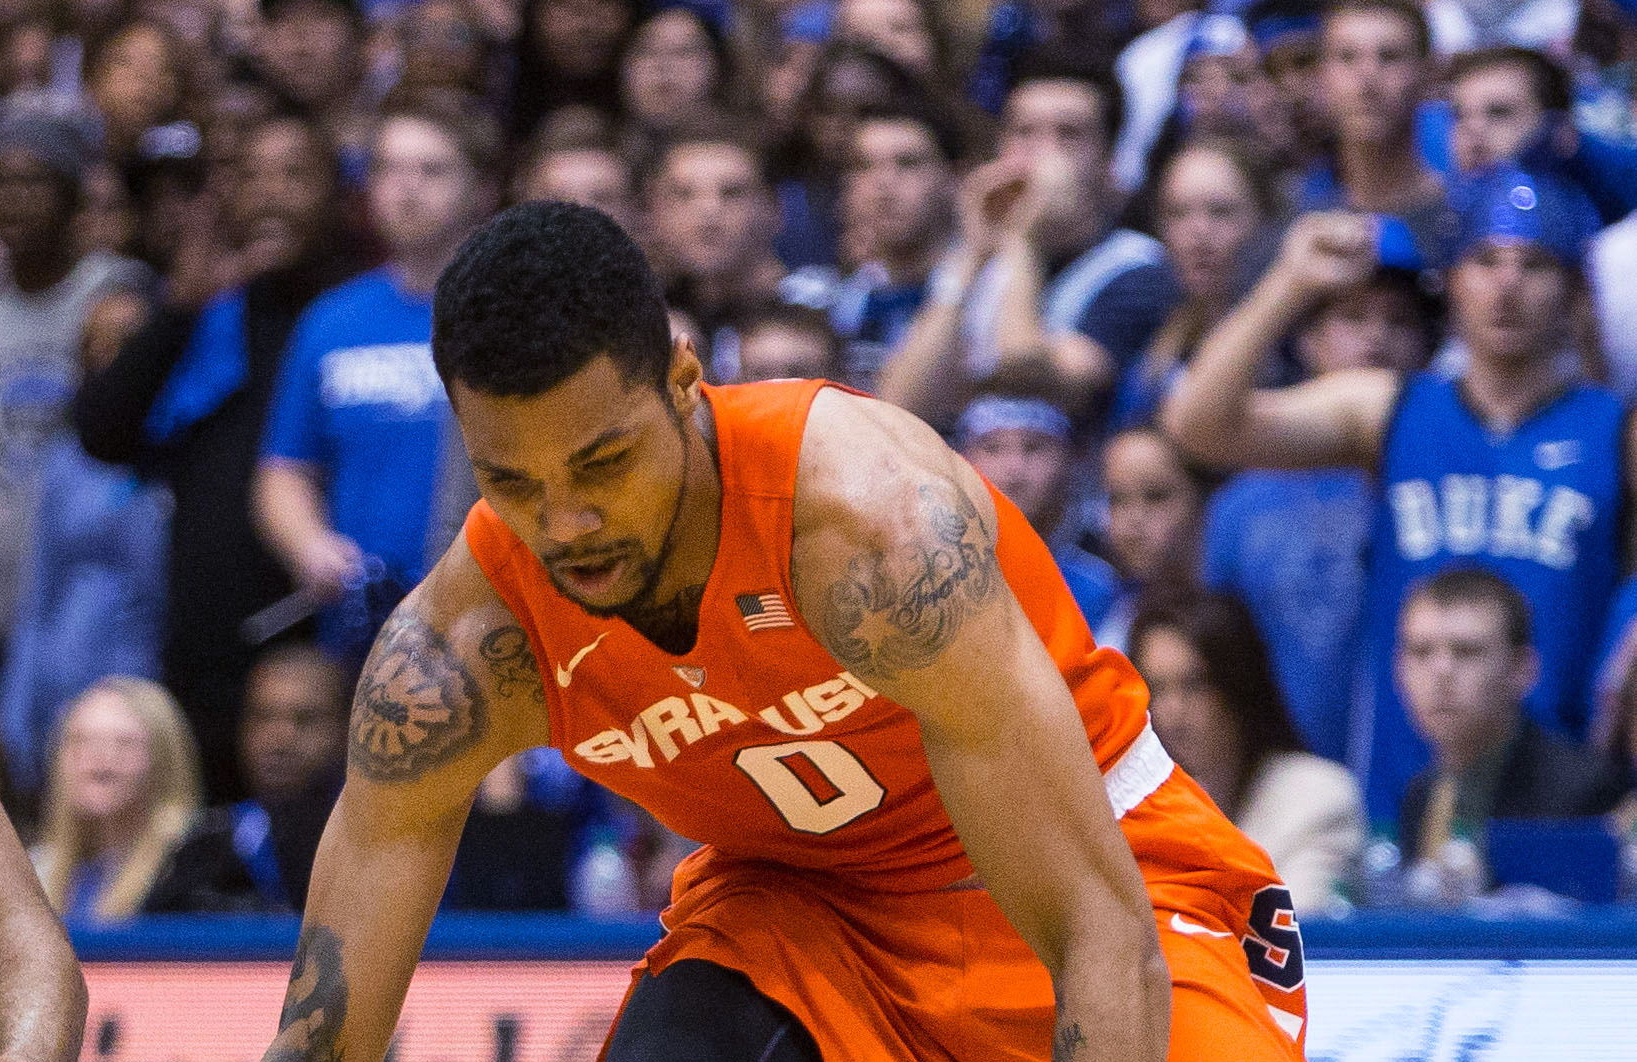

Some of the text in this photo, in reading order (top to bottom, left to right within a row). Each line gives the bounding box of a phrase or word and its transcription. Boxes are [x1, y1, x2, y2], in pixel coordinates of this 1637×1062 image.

[1389, 474, 1595, 570] DUKE
[573, 671, 879, 768] SYRAUS
[731, 740, 887, 836] 0
